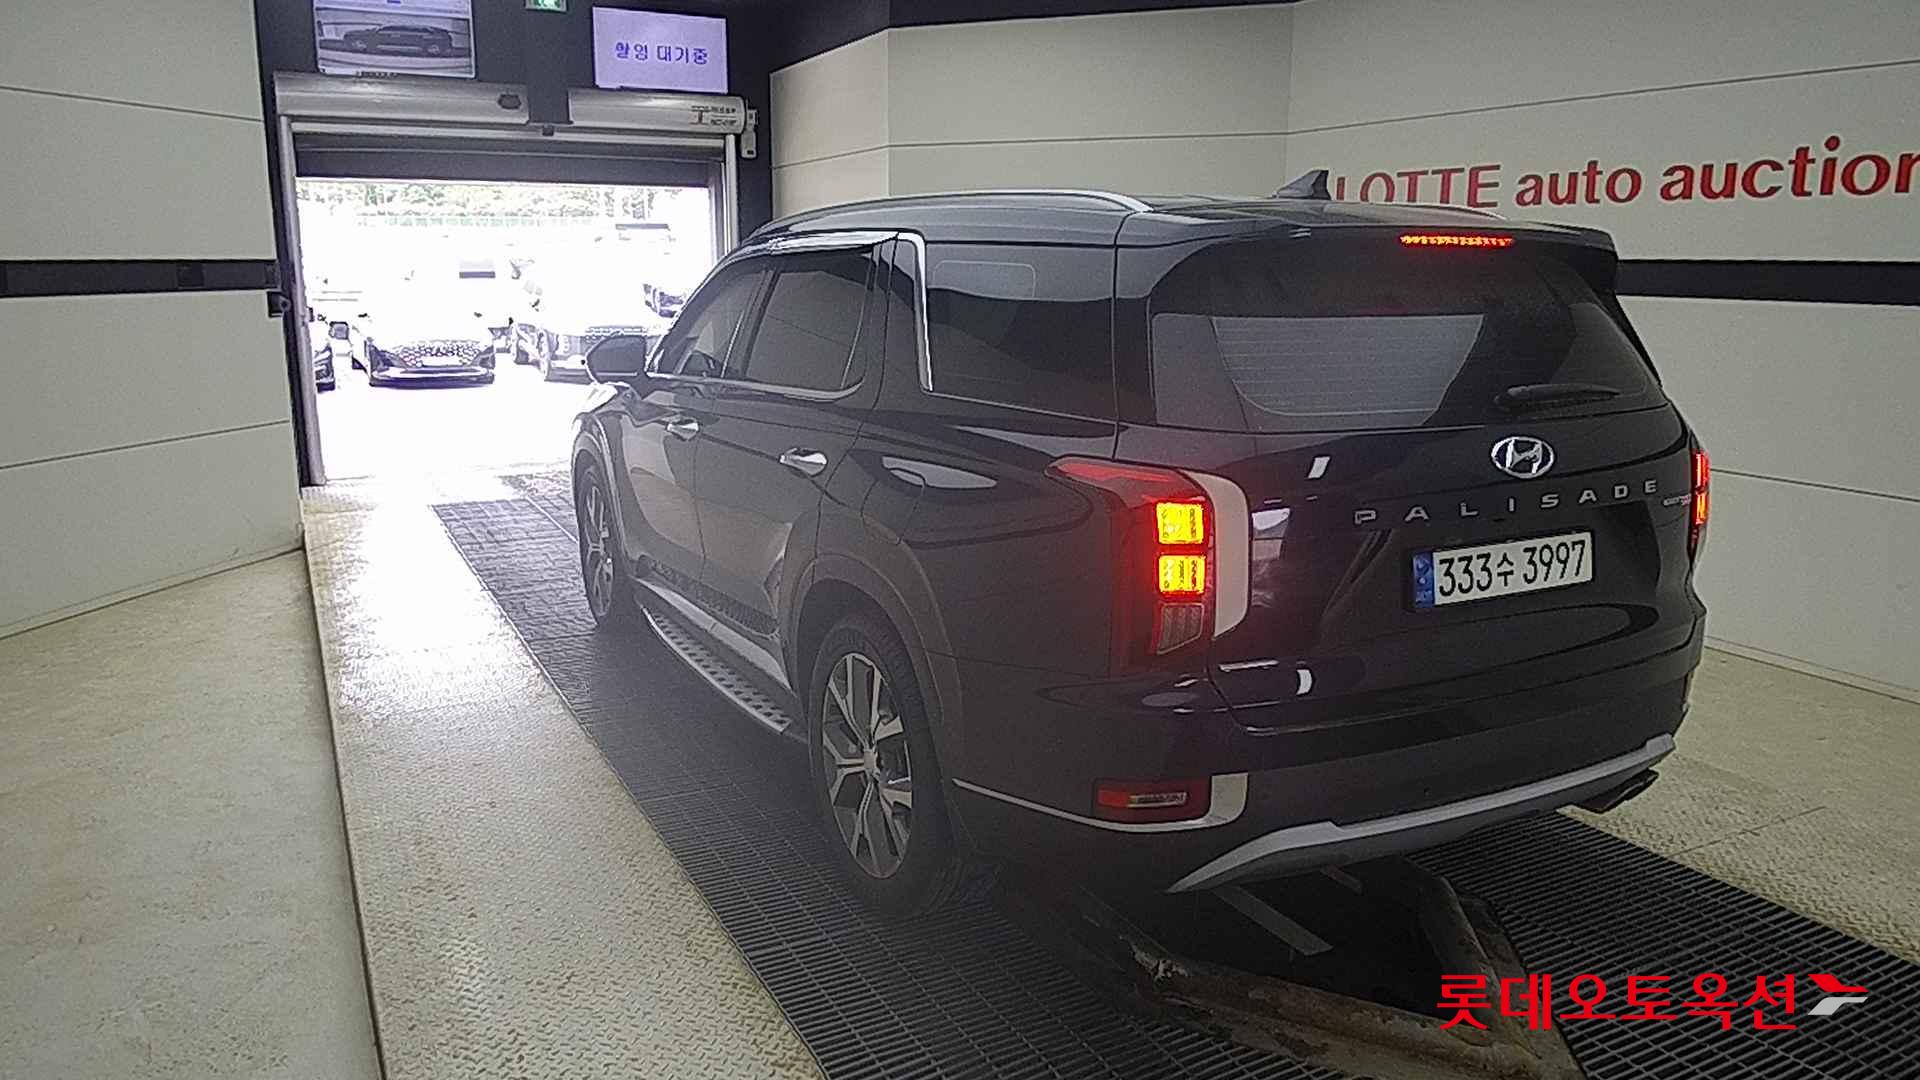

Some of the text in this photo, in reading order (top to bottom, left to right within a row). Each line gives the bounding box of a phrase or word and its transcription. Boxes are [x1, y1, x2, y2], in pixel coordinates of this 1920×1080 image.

[656, 45, 708, 65] 대기중
[1515, 160, 1642, 207] auto
[1354, 479, 1657, 524] PALISADE
[1438, 539, 1586, 597] 333수 3997
